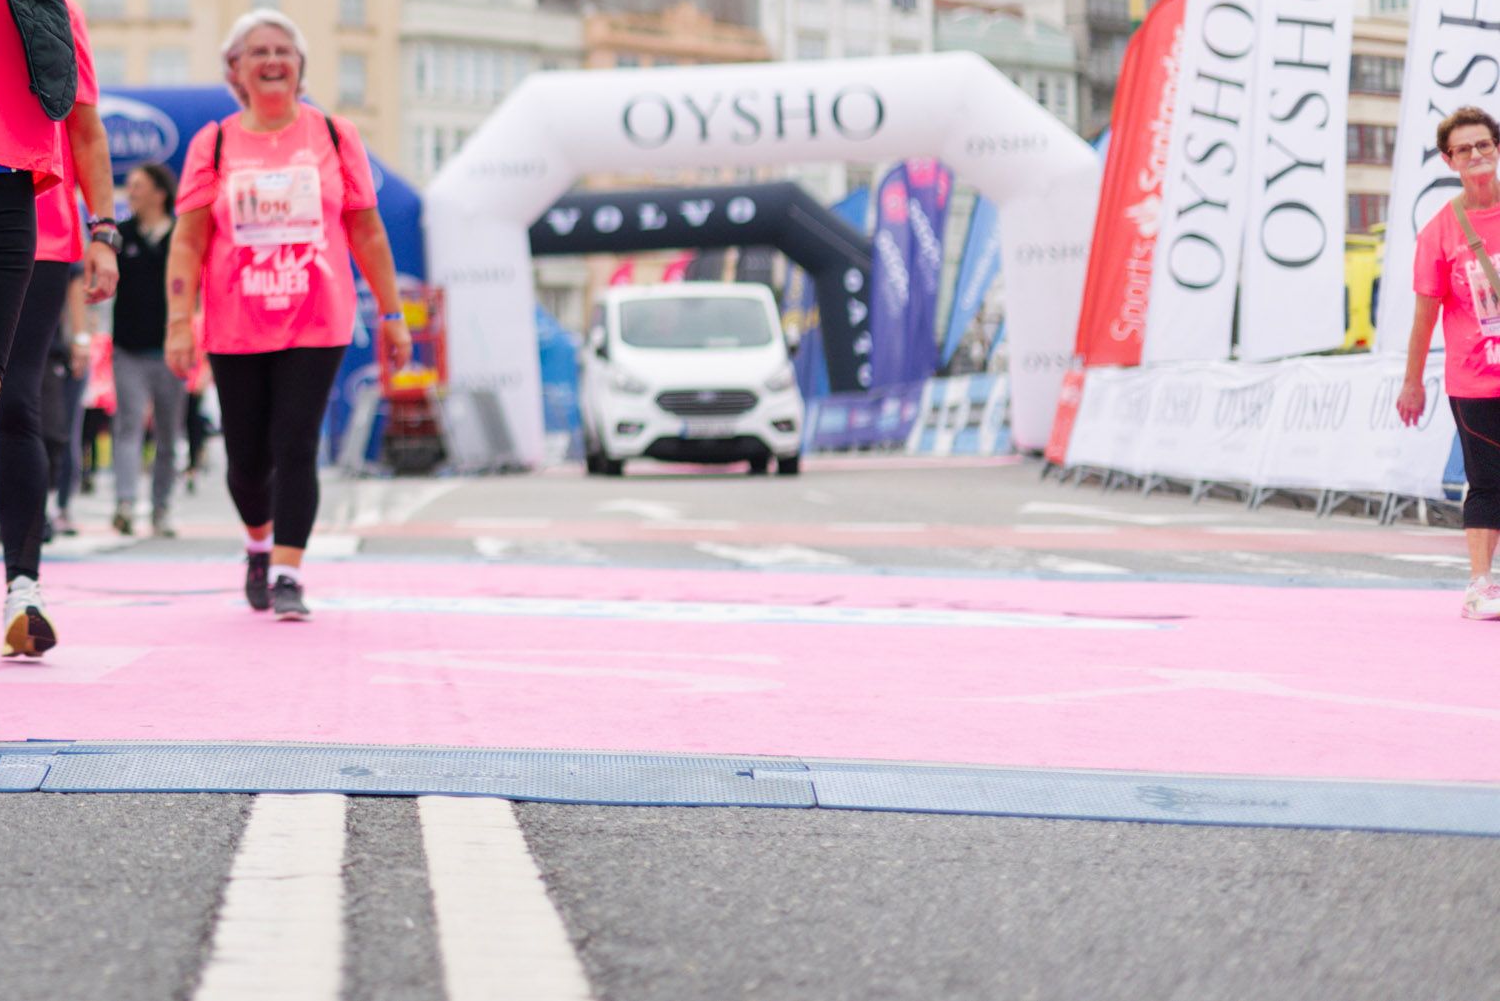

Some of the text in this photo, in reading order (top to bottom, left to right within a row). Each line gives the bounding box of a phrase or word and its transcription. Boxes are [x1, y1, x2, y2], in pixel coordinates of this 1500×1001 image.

[622, 83, 886, 149] OYSHO
[1167, 0, 1255, 291] OYSHO
[546, 197, 757, 236] VOLVO
